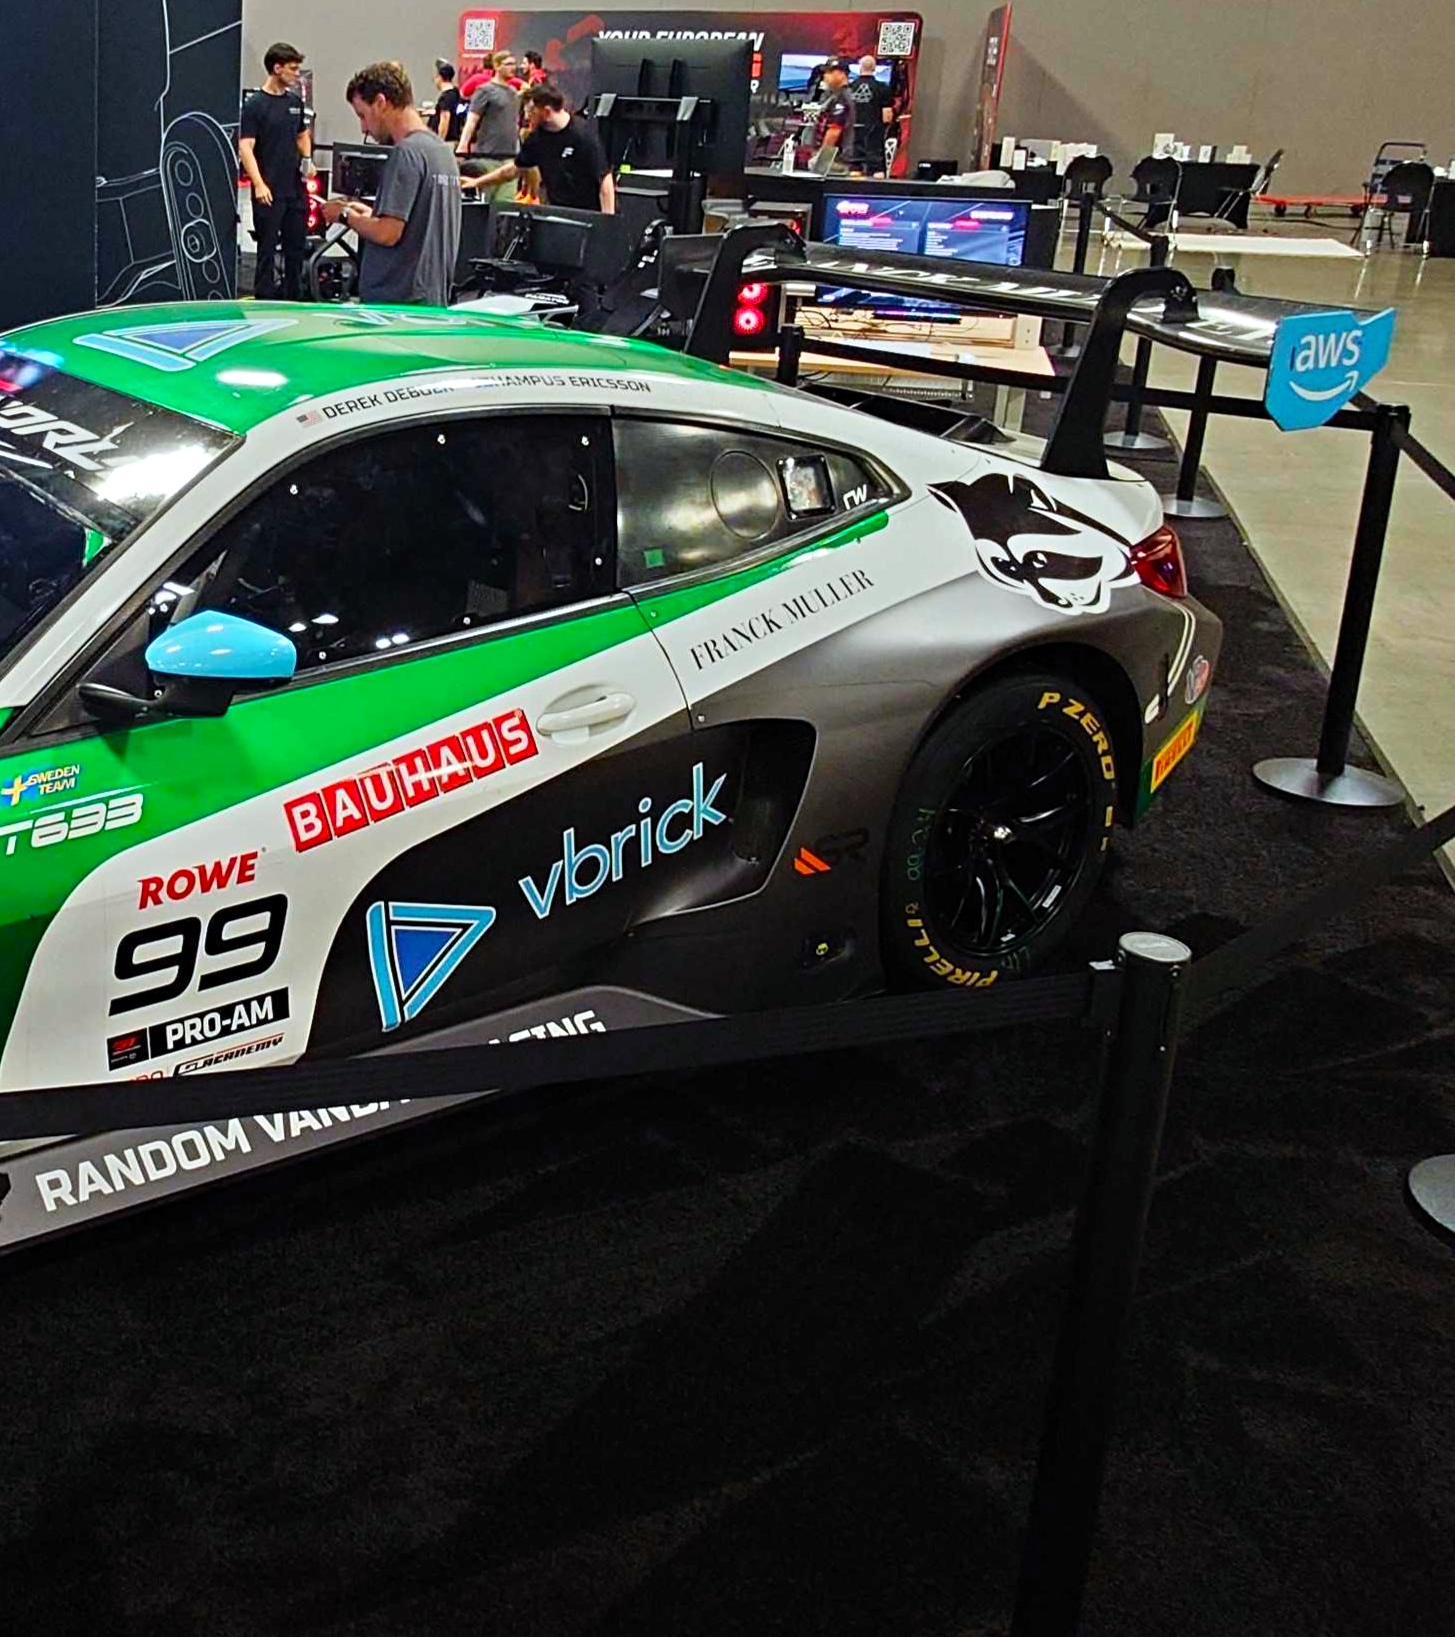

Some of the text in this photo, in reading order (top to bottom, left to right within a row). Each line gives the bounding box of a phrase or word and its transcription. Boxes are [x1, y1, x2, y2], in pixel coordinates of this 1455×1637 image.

[1296, 330, 1363, 373] aws
[322, 394, 382, 420] DEREK
[569, 376, 652, 394] ERICSSON
[690, 569, 875, 670] FRANCK MULLER
[1038, 692, 1116, 780] P ZERO
[26, 764, 80, 786] SWEDEN
[39, 778, 76, 795] TEAM
[288, 713, 534, 848] BAUHAUS
[518, 762, 727, 919] vbrick
[137, 851, 258, 910] ROWE
[108, 893, 289, 1017] 99
[905, 918, 998, 988] PIRELLI
[165, 995, 274, 1050] PRO-AM
[35, 1116, 253, 1212] RANDOM
